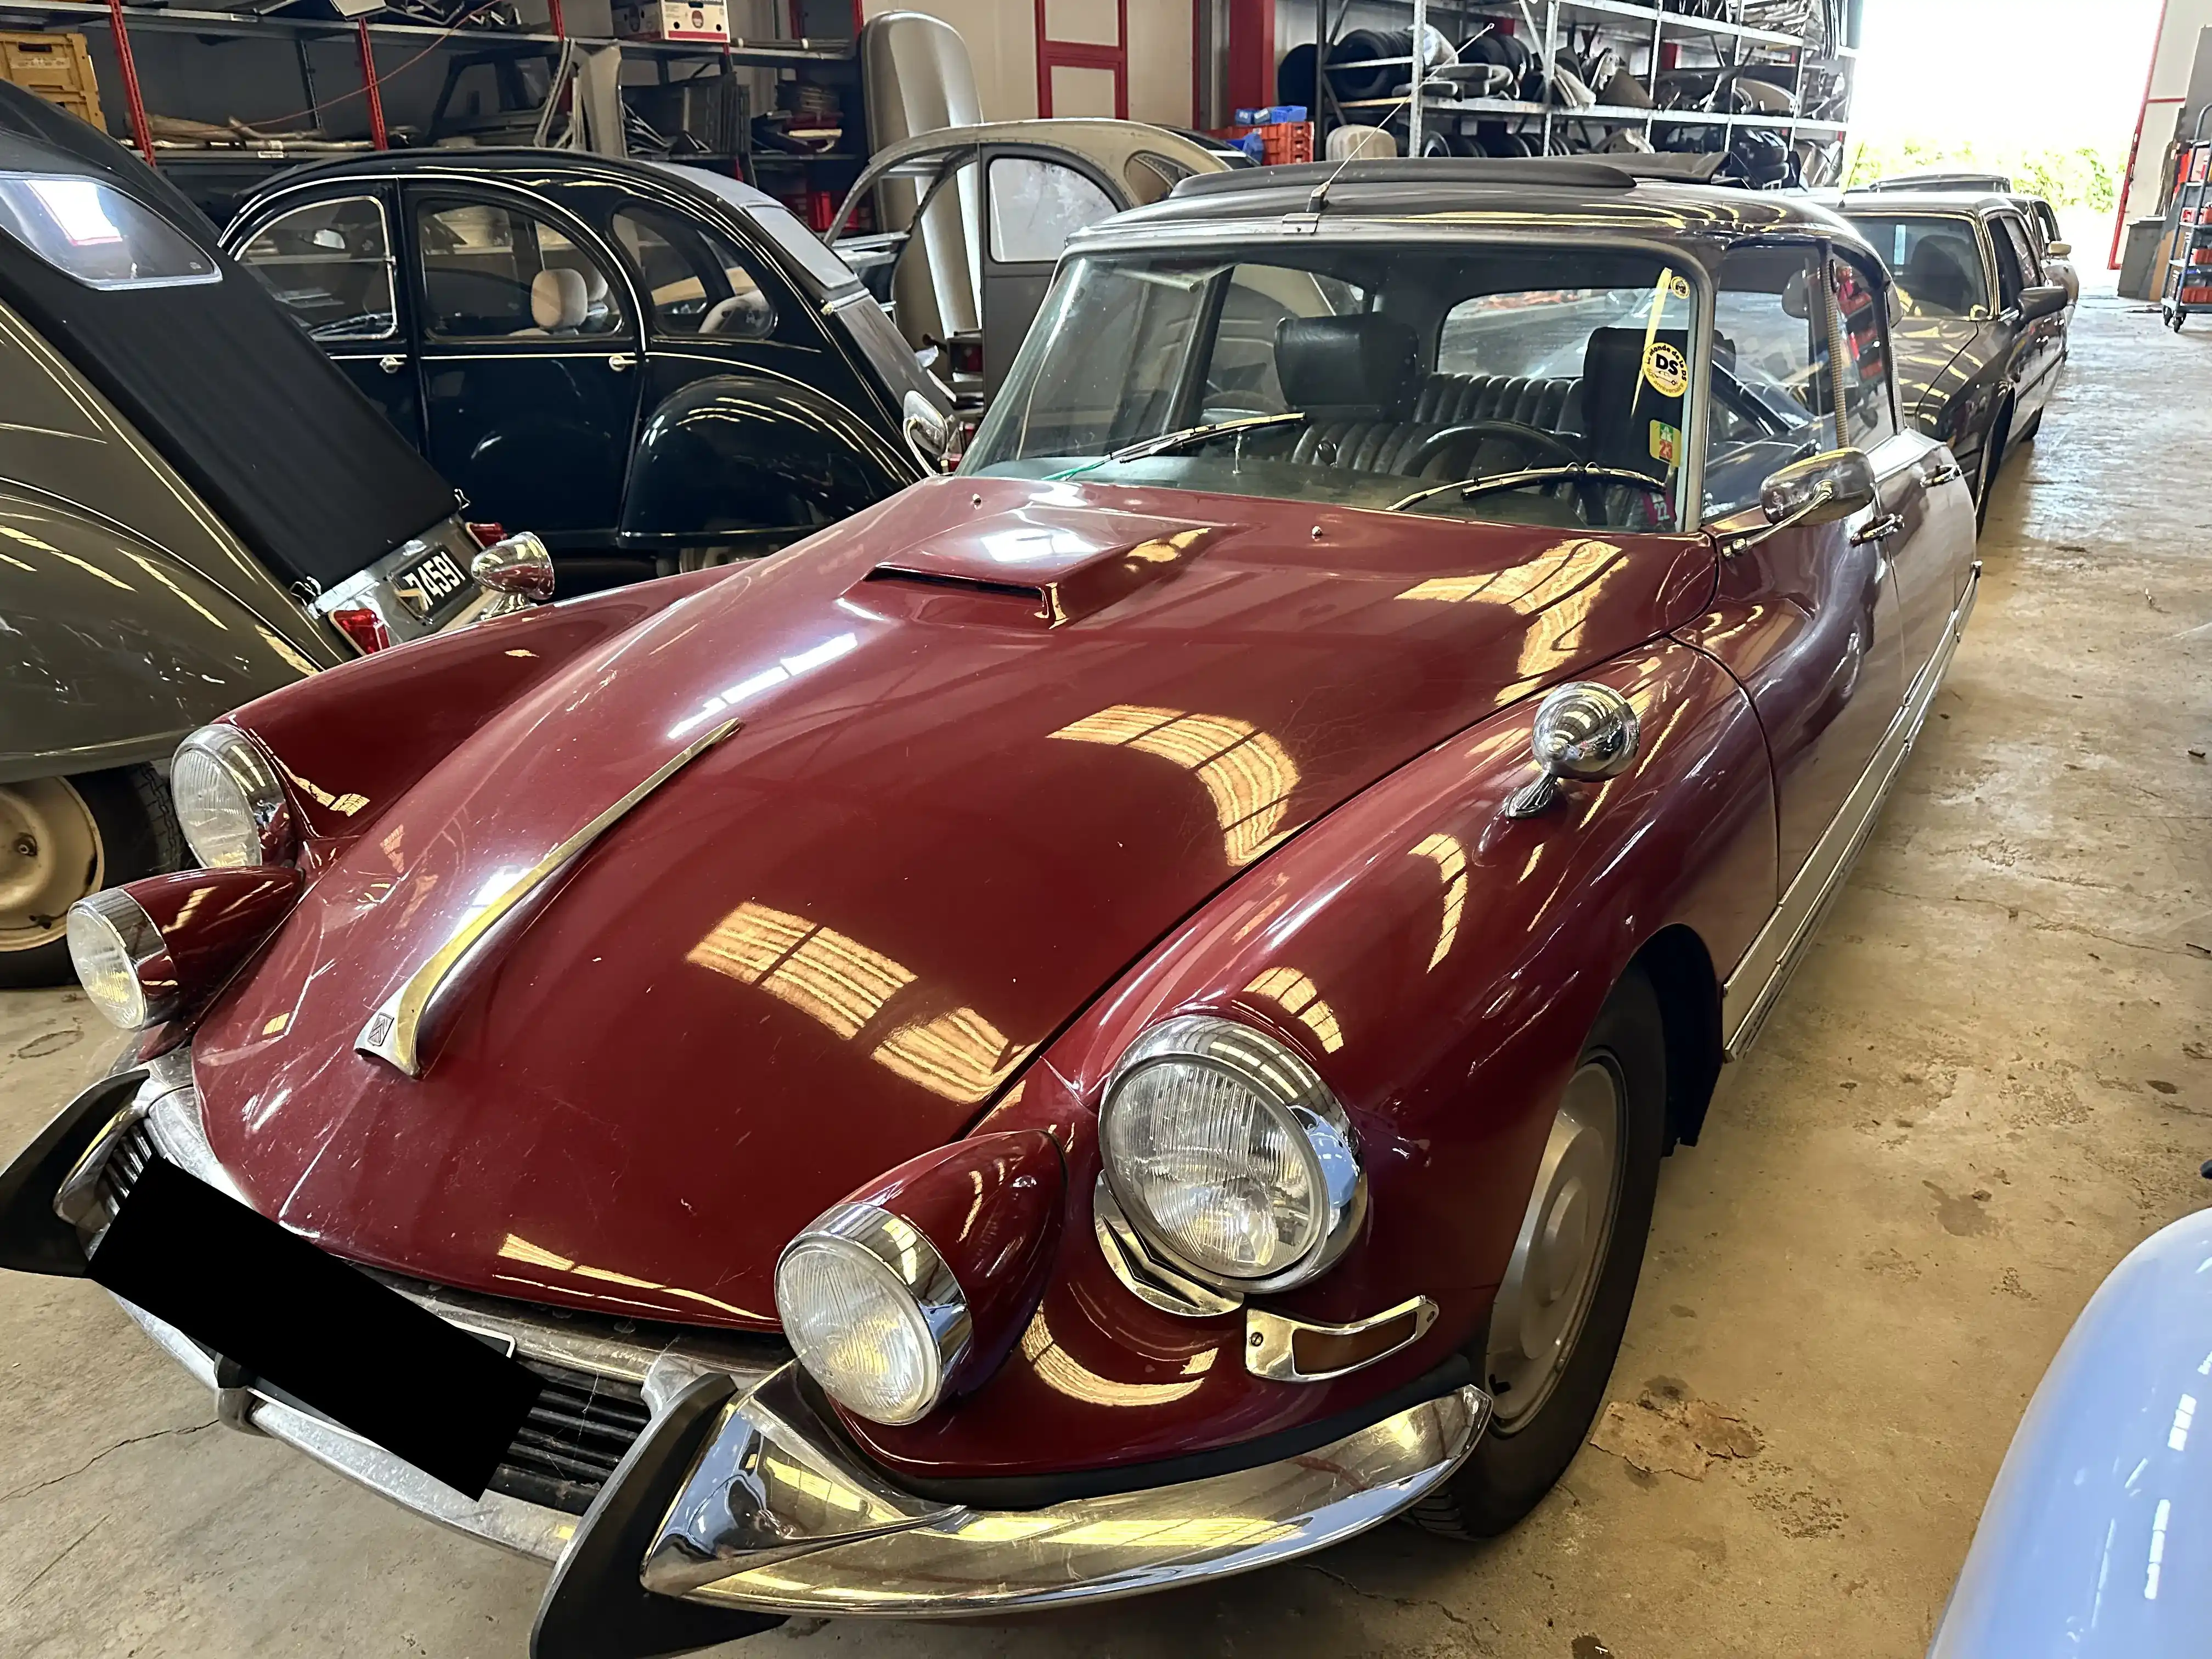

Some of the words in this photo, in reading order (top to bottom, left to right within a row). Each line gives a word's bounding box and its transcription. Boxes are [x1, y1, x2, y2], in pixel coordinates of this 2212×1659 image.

[1656, 353, 1679, 376] DS
[1672, 351, 1680, 360] de
[1681, 370, 1687, 381] DS
[402, 551, 466, 606] 74591
